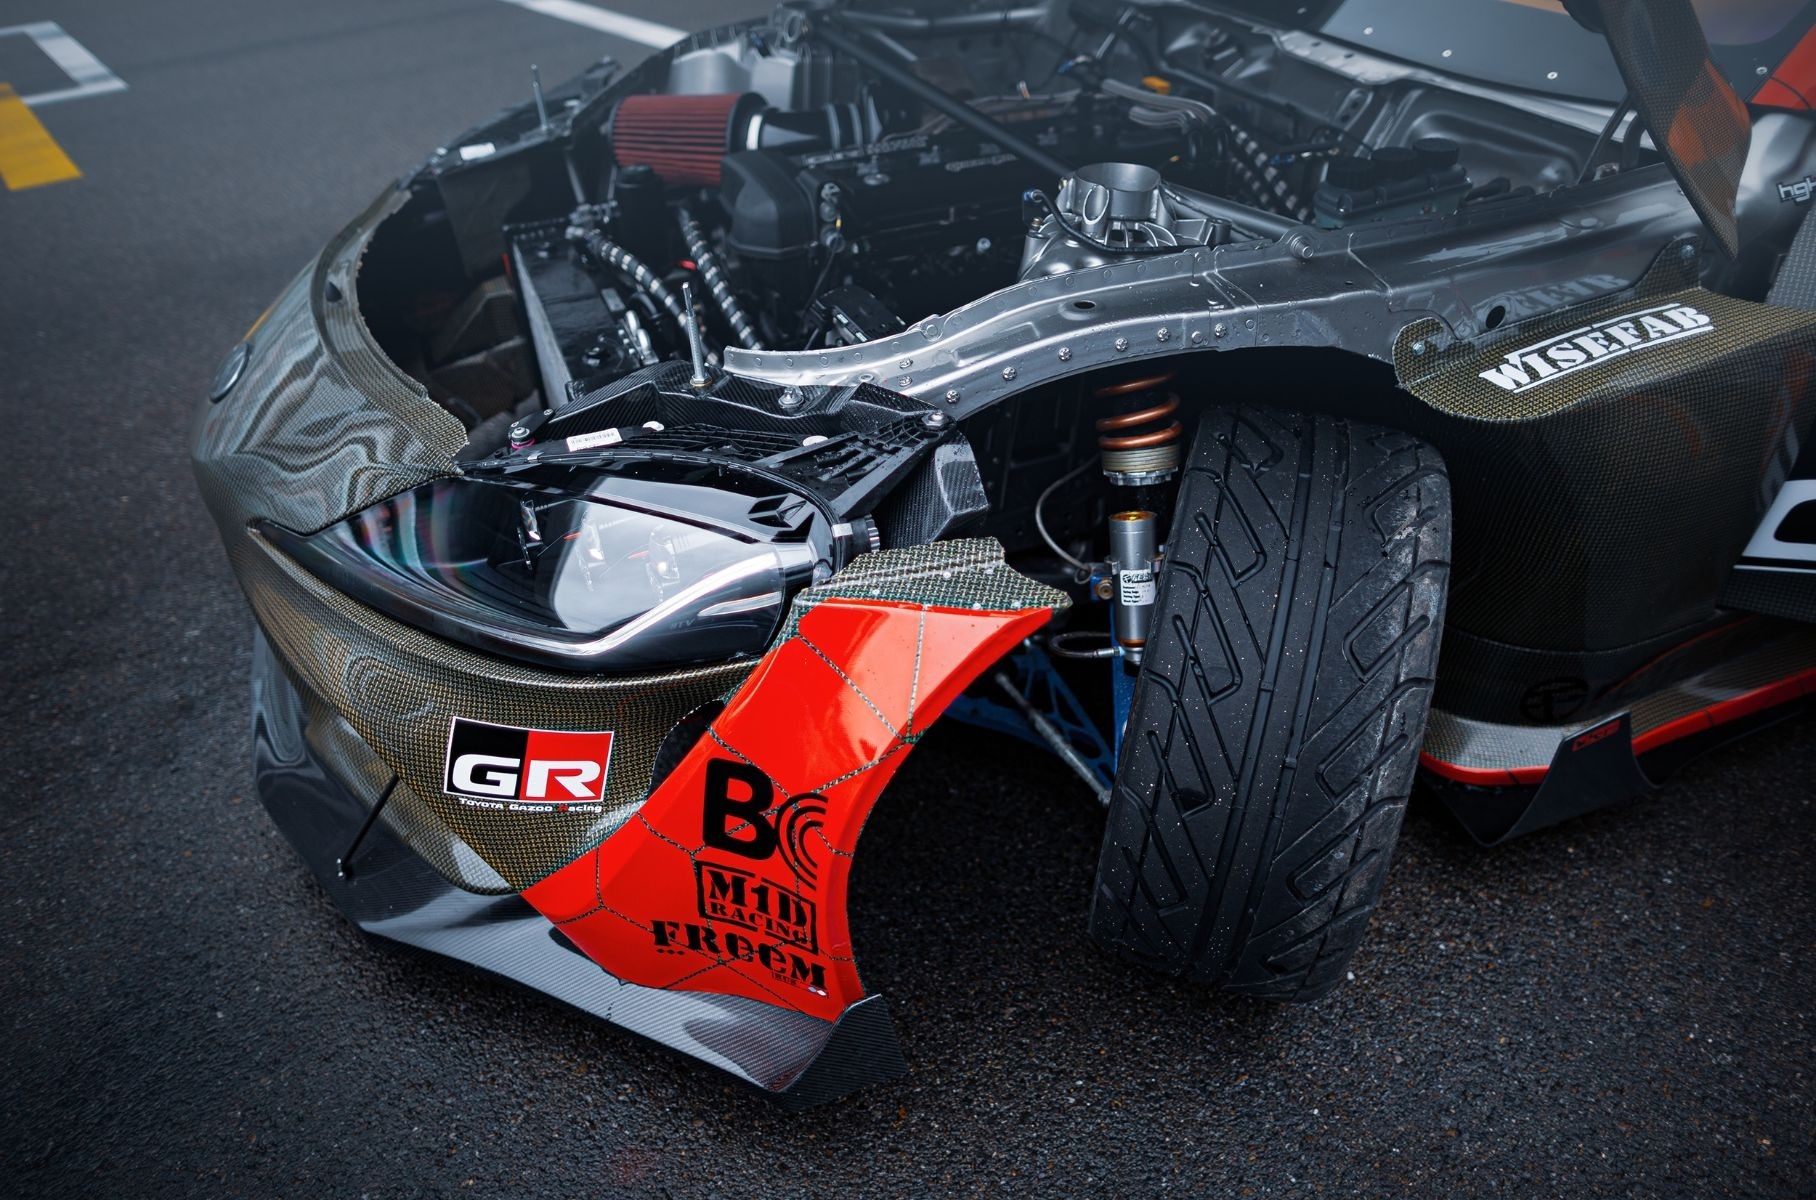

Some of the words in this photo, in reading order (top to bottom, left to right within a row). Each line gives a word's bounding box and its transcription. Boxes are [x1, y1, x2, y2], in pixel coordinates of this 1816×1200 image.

[1478, 306, 1712, 391] WISEFAB
[452, 753, 602, 798] GR
[708, 869, 808, 928] M1D
[709, 901, 810, 945] RACING
